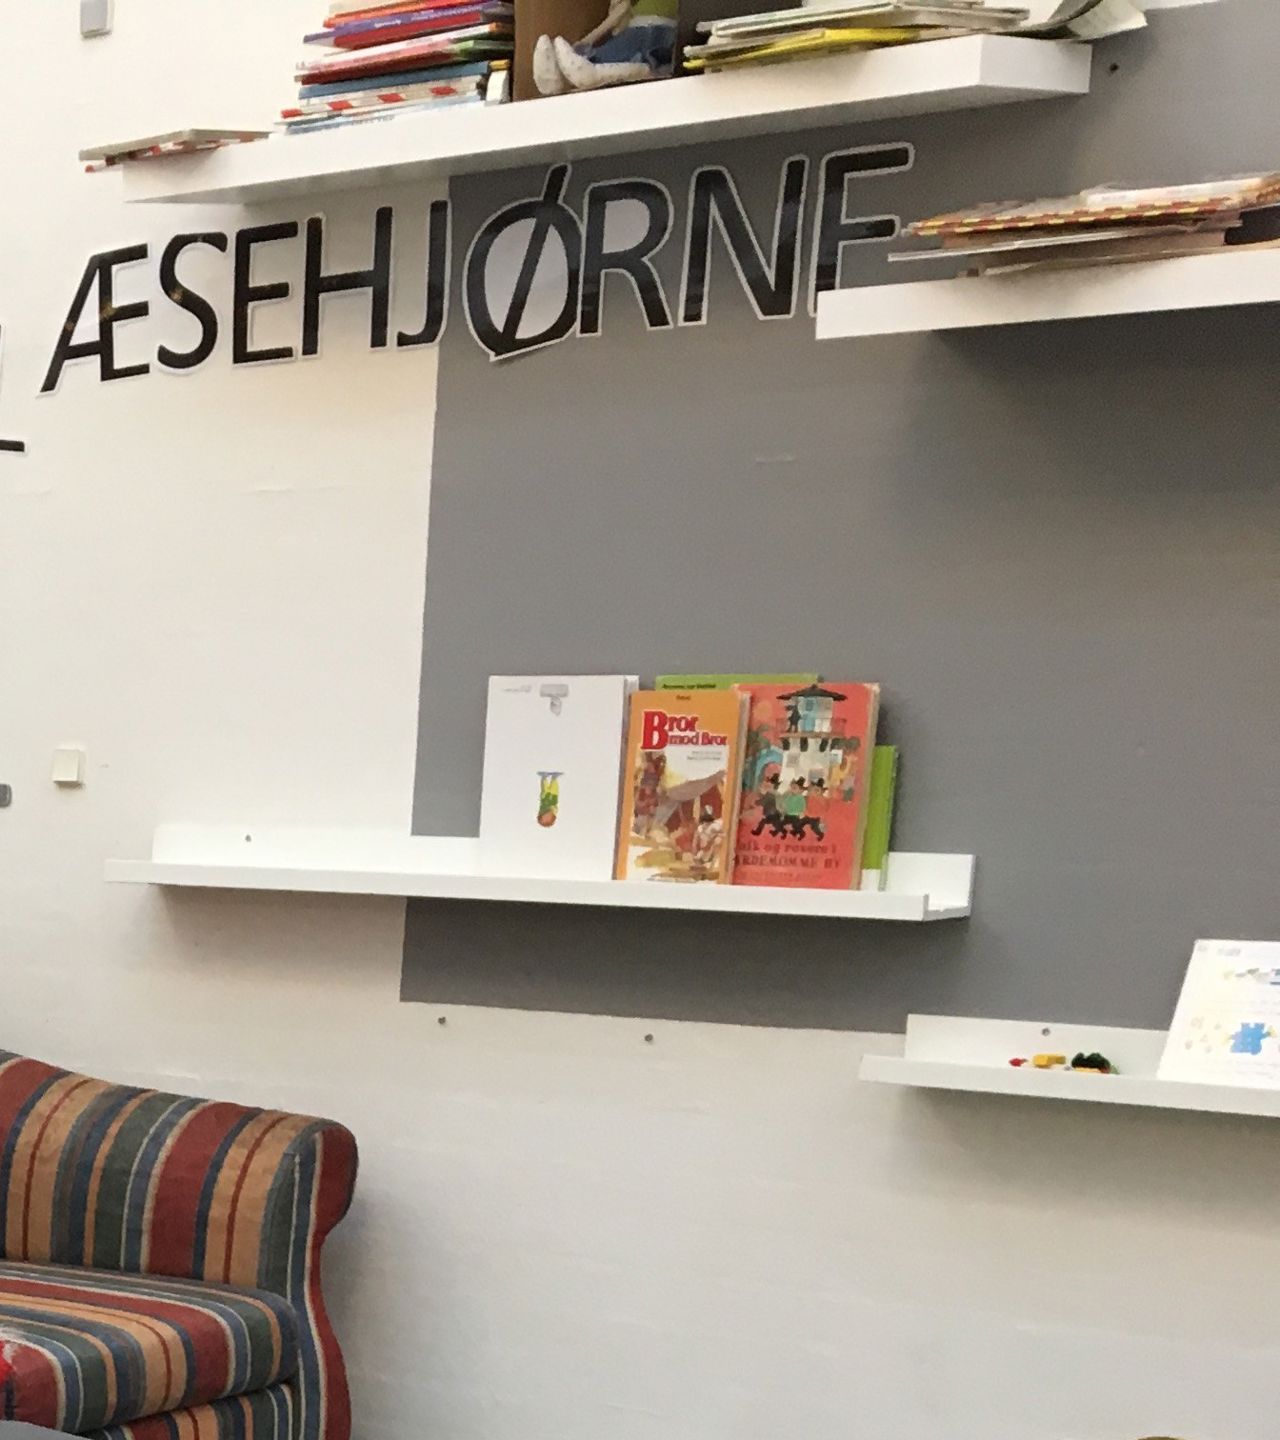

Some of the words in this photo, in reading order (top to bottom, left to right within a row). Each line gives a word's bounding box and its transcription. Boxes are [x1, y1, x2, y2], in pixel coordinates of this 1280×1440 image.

[641, 710, 699, 750] Bror
[669, 732, 700, 746] mod
[701, 732, 727, 746] Bror
